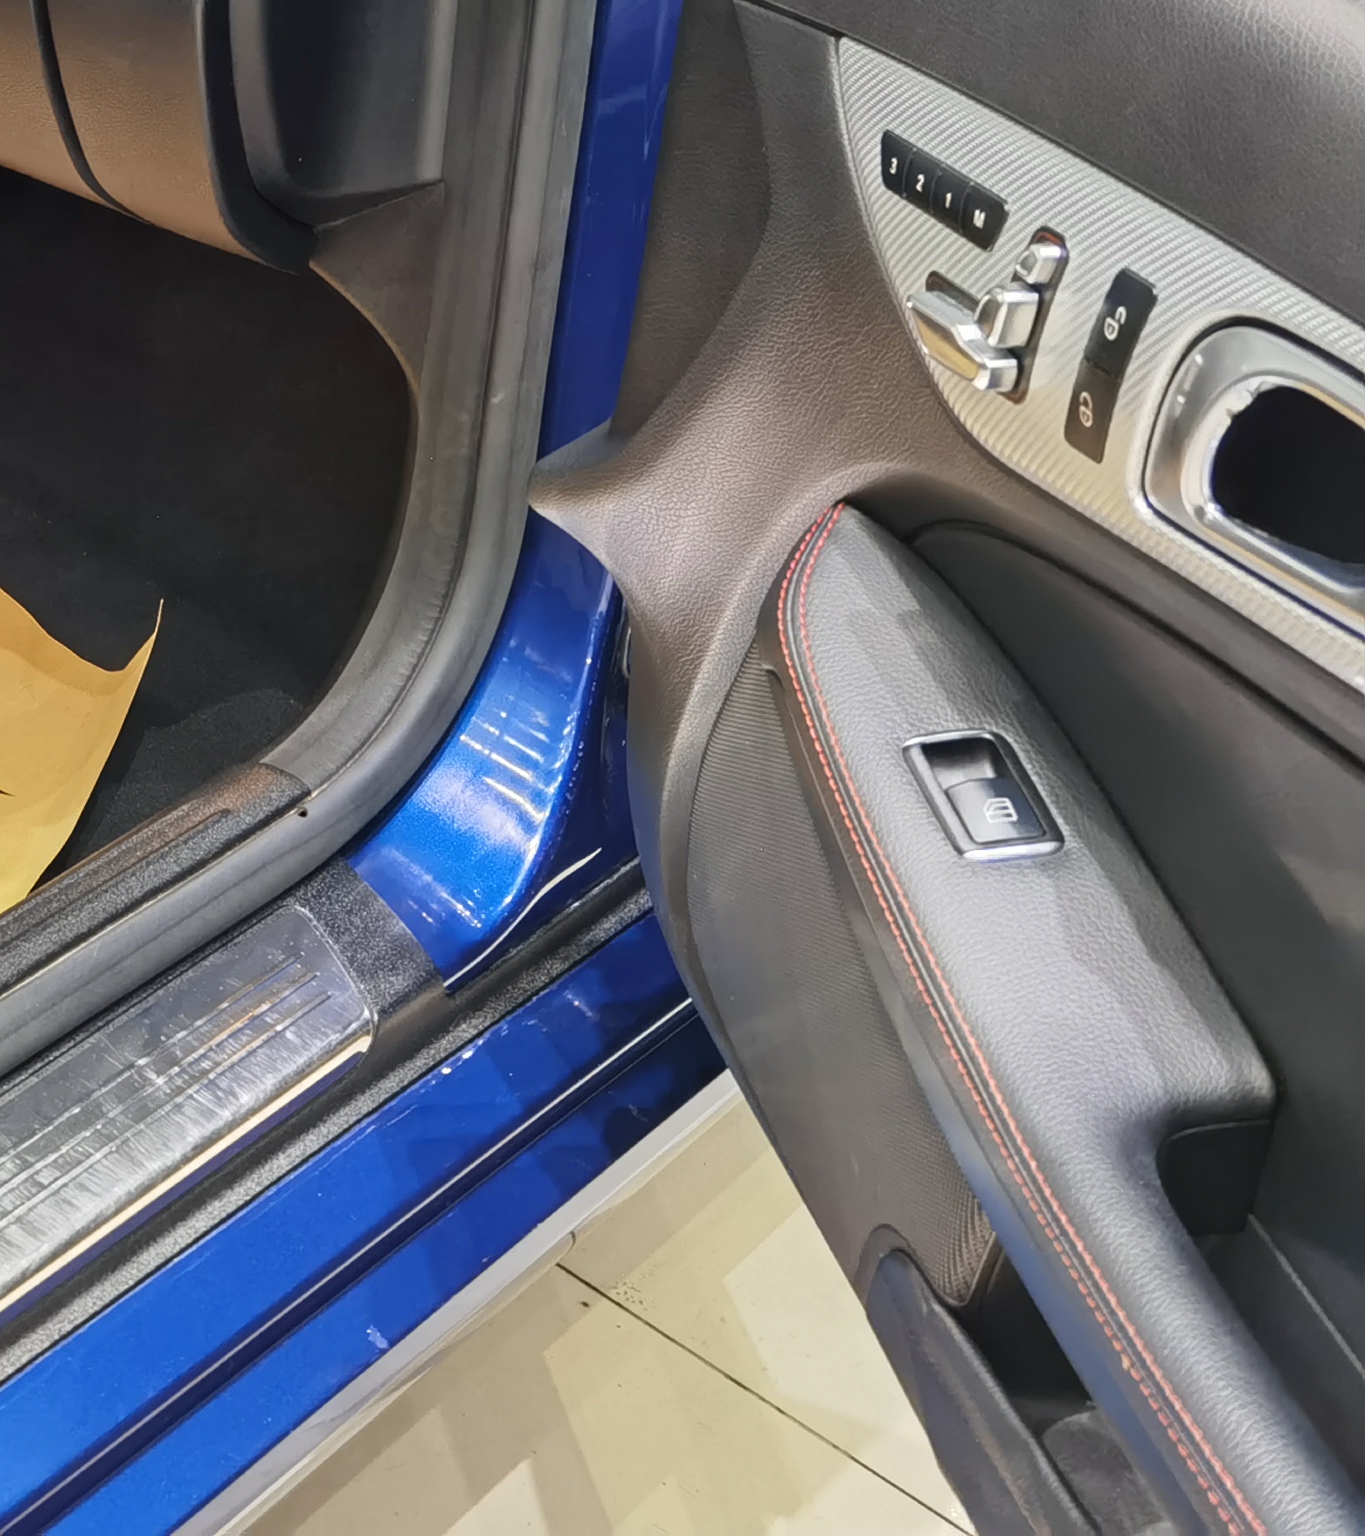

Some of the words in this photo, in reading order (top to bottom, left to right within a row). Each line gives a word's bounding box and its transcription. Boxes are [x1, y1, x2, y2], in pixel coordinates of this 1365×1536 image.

[889, 157, 898, 175] 3
[915, 173, 925, 193] 2
[973, 209, 986, 229] M
